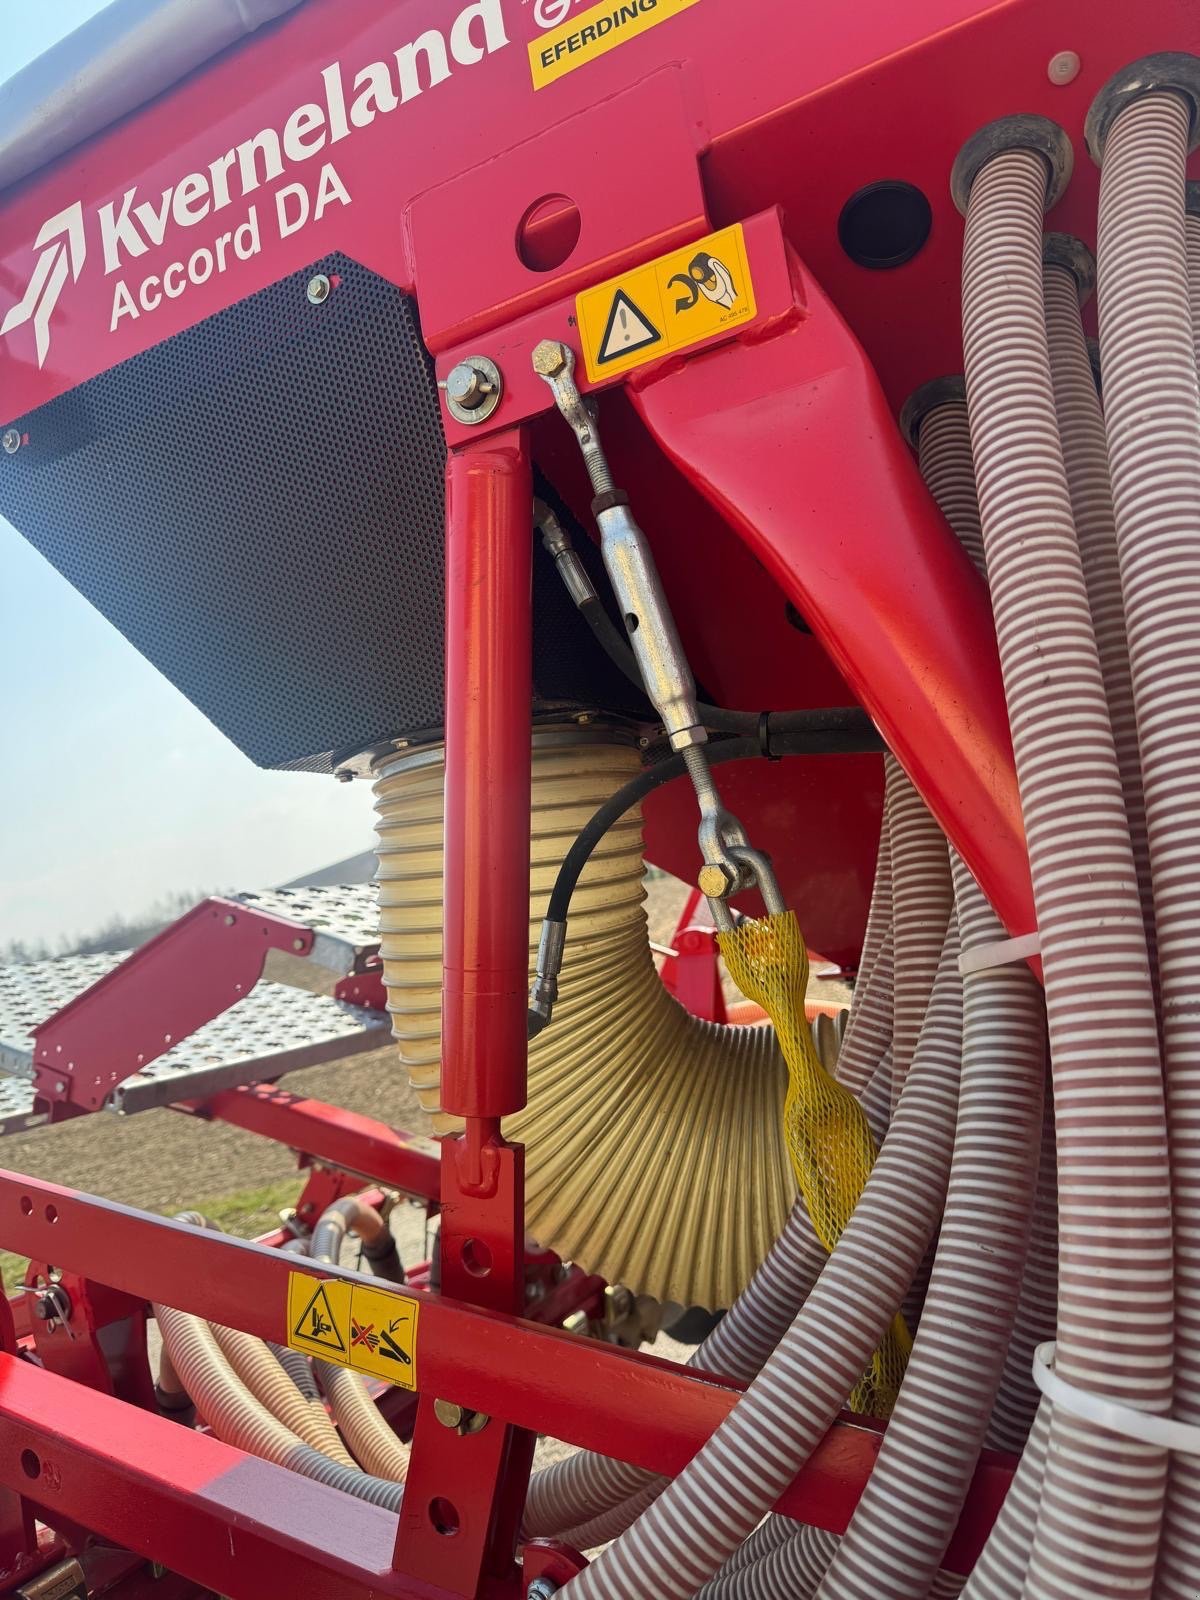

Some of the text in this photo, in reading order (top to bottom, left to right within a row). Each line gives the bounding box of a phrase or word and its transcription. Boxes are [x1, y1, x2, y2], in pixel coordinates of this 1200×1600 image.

[540, 0, 658, 68] EFERDING
[98, 0, 511, 275] Kverneland
[109, 162, 352, 332] Accord DA
